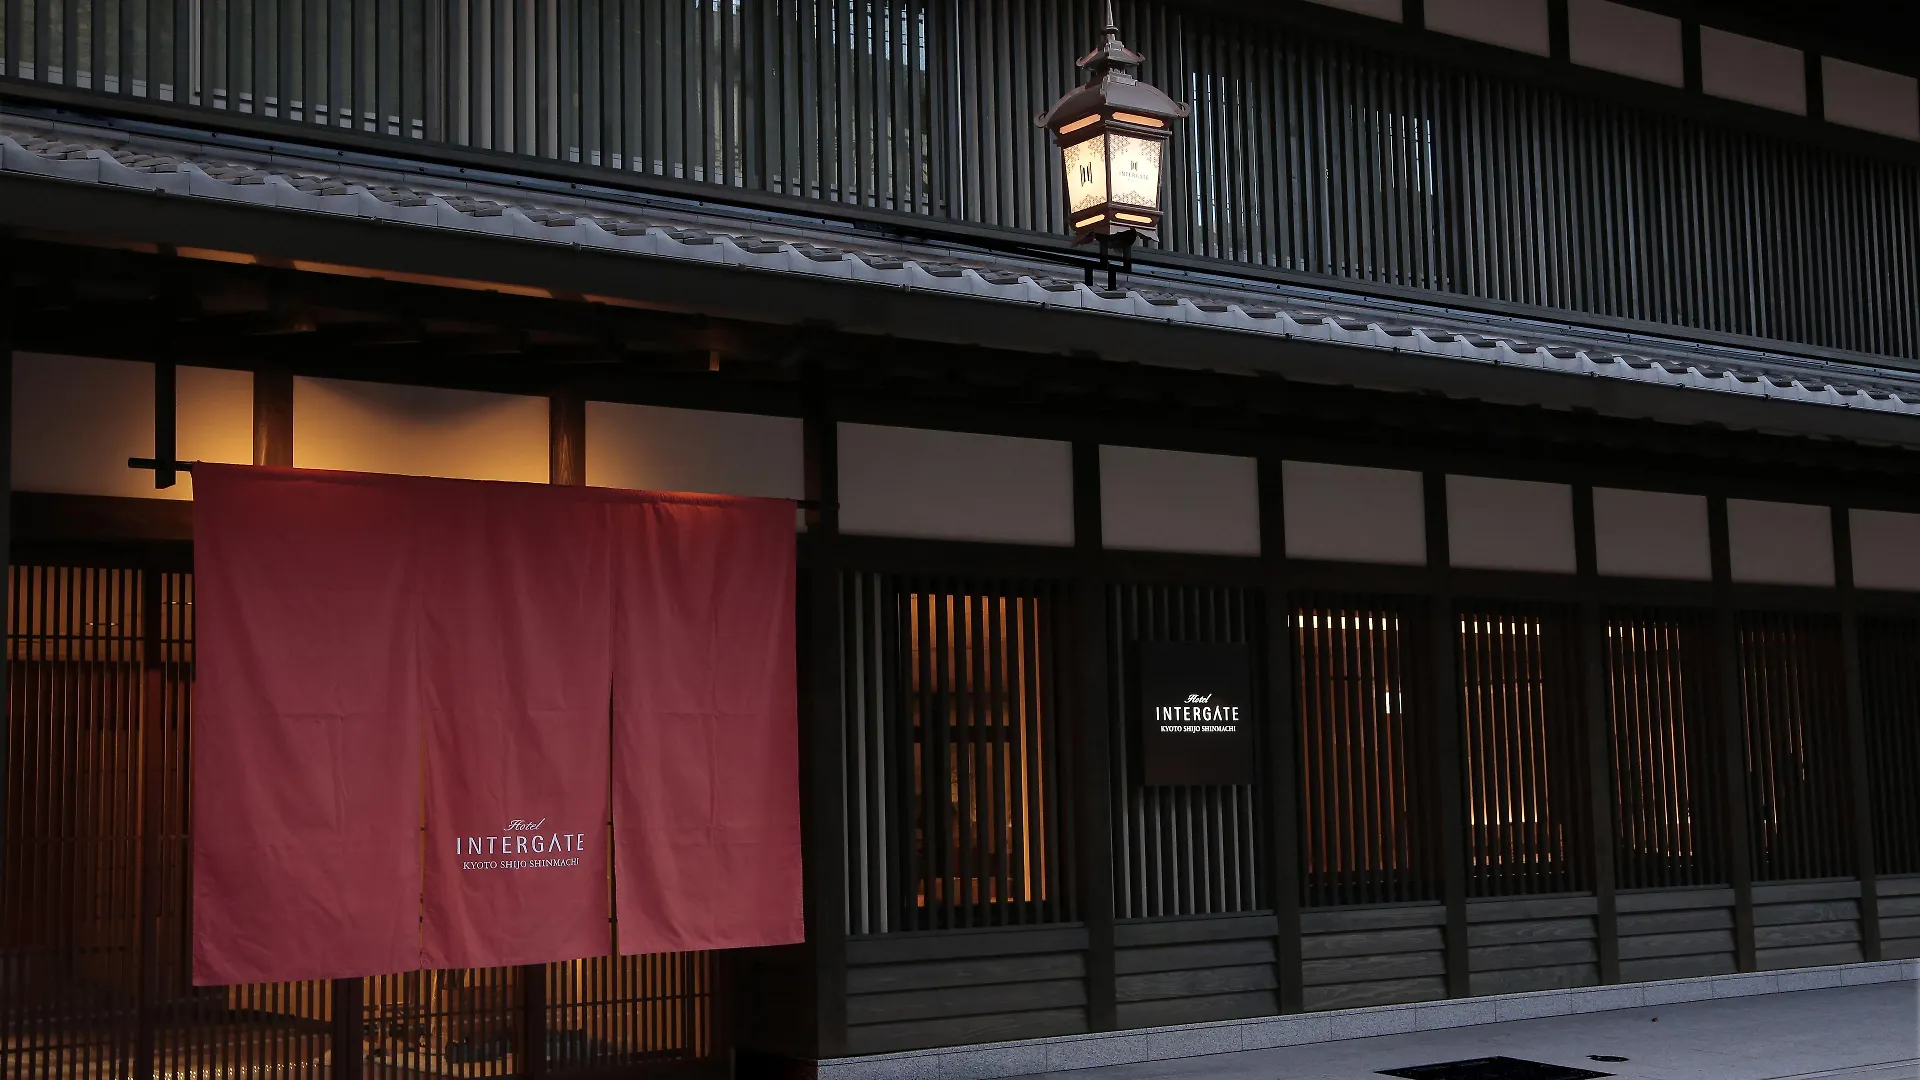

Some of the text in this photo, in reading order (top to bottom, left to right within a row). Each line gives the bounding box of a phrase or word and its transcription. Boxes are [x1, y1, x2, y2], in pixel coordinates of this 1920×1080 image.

[1184, 693, 1212, 704] Hotel
[1156, 705, 1240, 721] INTERGATE
[1183, 725, 1200, 733] SHIJO
[503, 817, 546, 831] Hotel
[456, 833, 585, 855] INTERGATE
[462, 857, 580, 870] KYOTO SHIJO SHINMACHI
